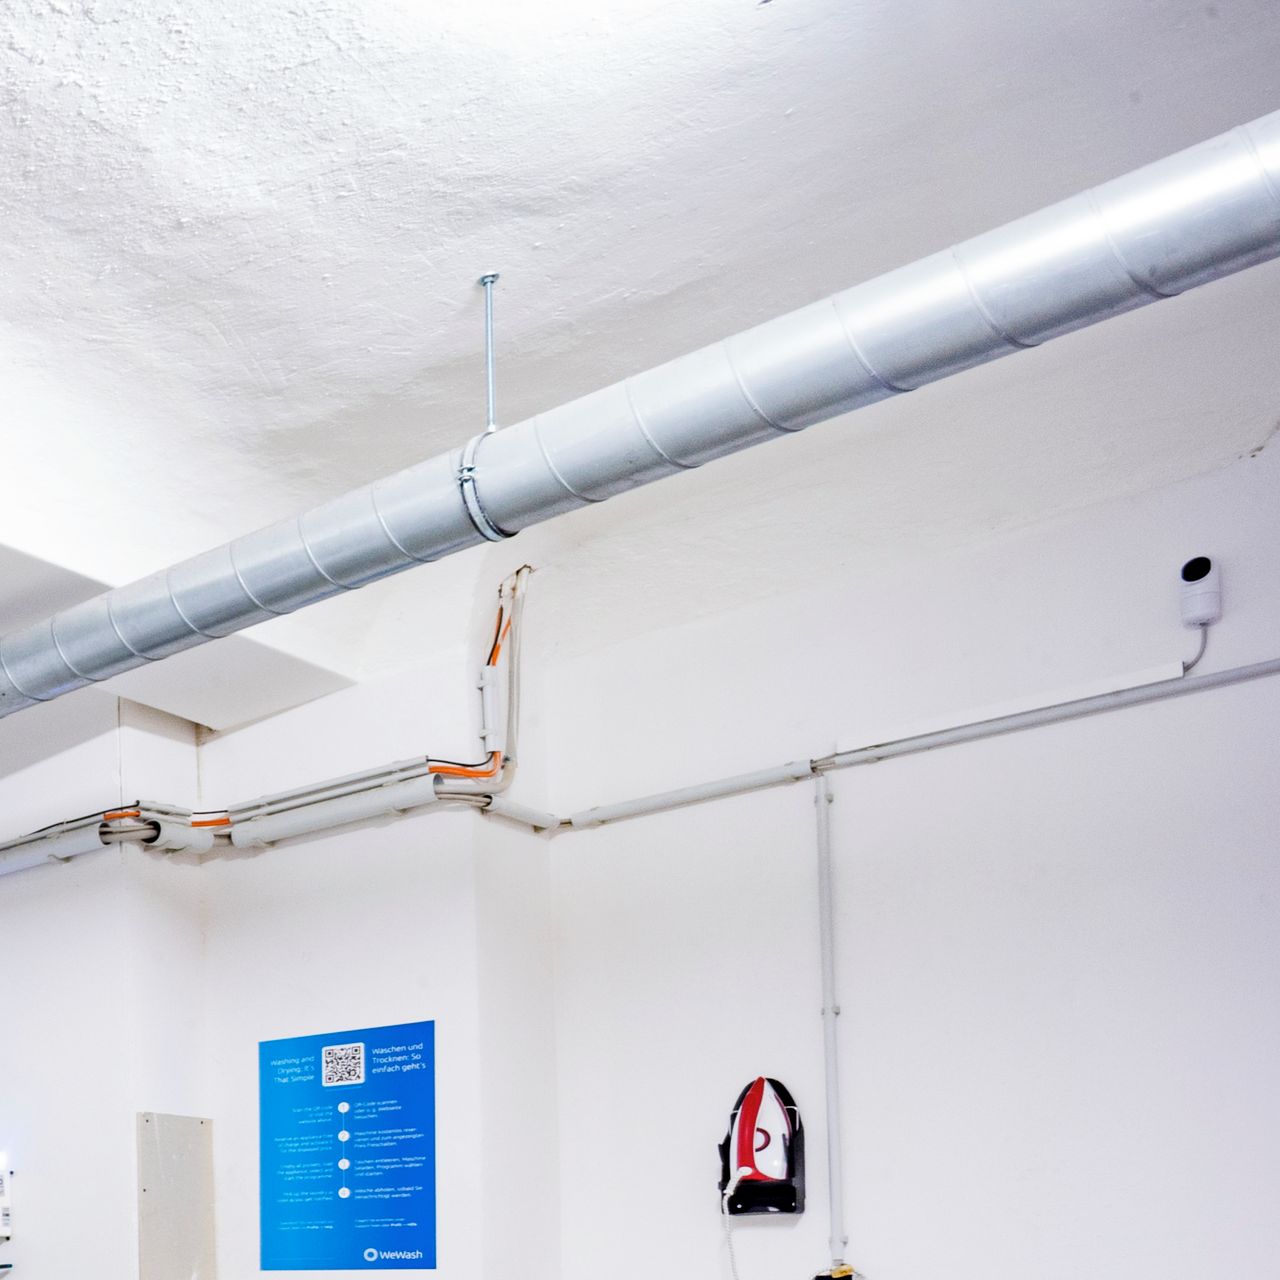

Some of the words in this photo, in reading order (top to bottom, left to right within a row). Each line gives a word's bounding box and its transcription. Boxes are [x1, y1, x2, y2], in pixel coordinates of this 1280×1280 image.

[372, 1045, 407, 1054] Waschen
[409, 1043, 424, 1051] und
[270, 1058, 300, 1067] Washing
[372, 1055, 409, 1064] Trocknen:
[411, 1053, 422, 1061] So
[372, 1064, 400, 1074] einfach
[401, 1062, 427, 1073] geht's
[290, 1075, 315, 1084] Simple
[379, 1250, 423, 1260] WeWash
